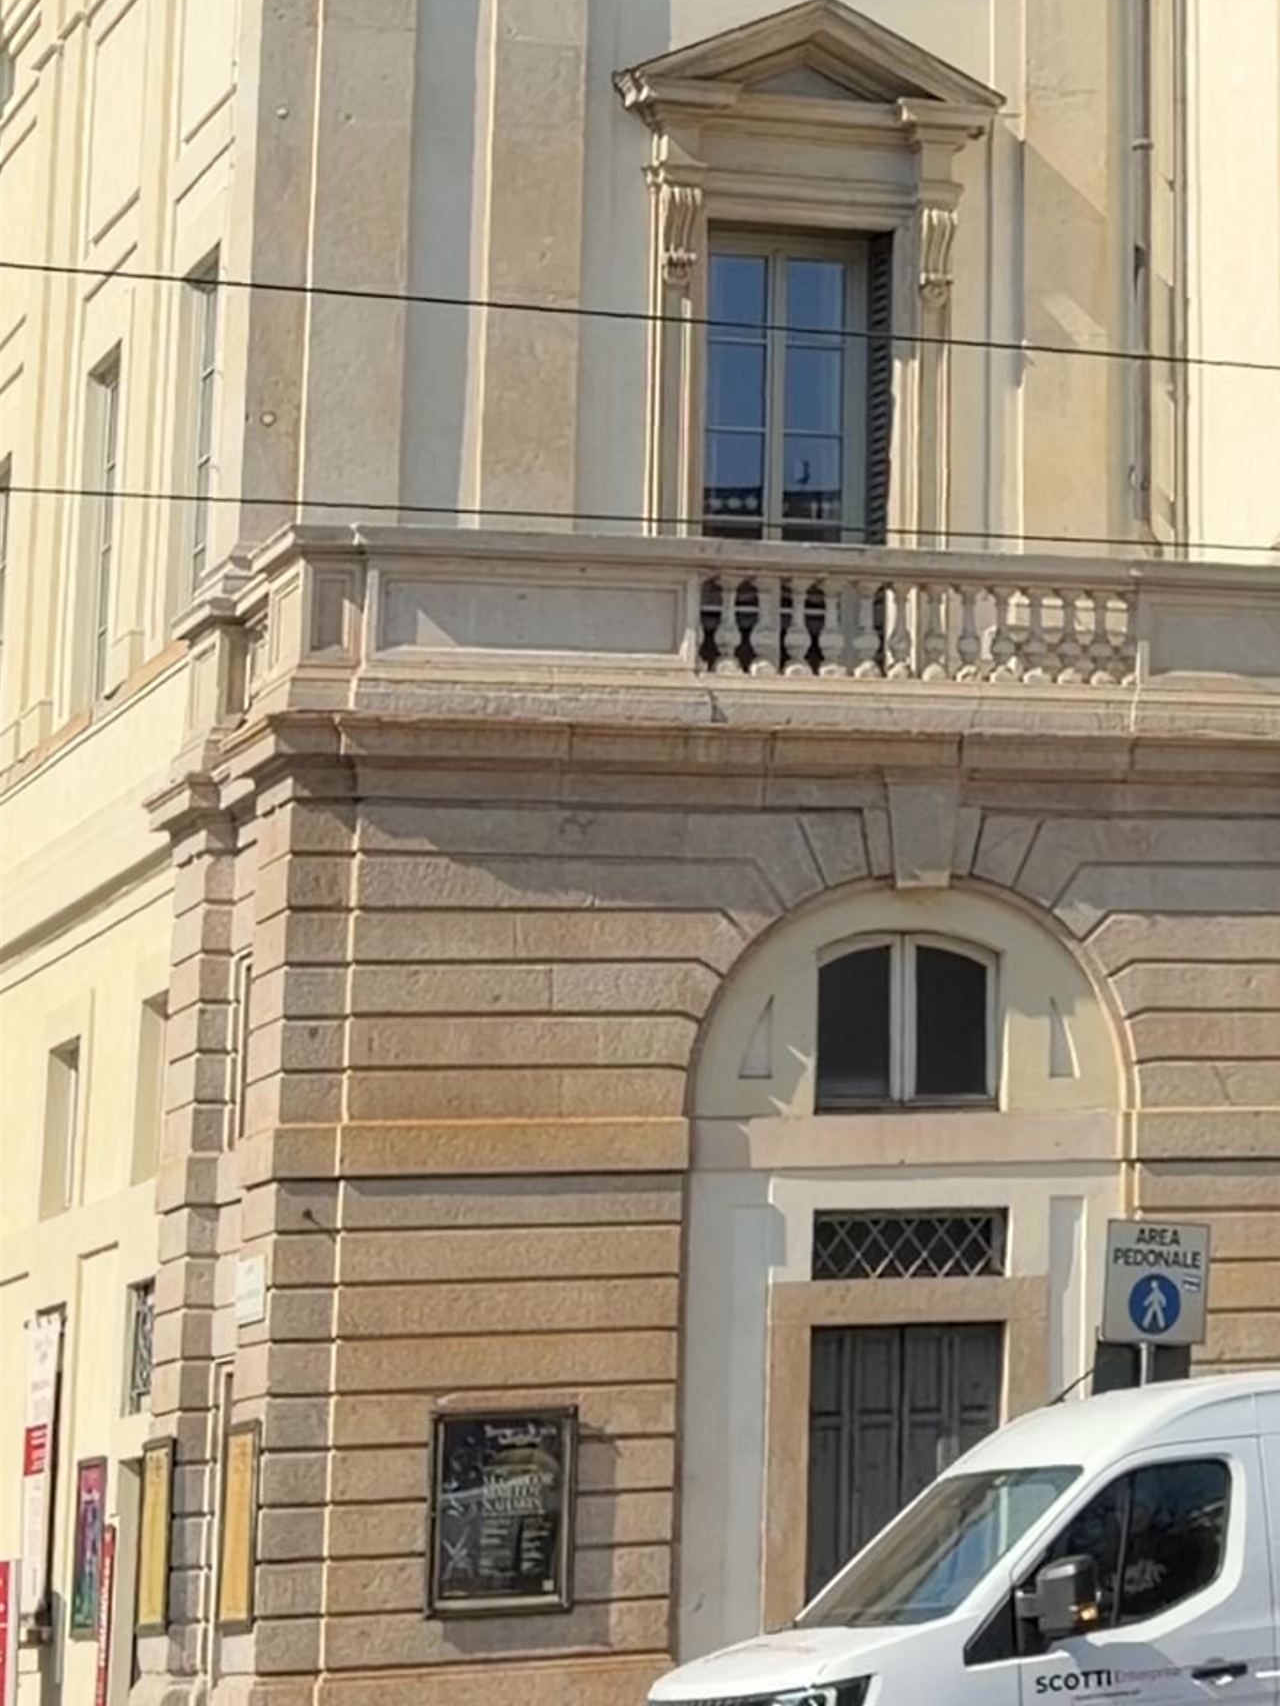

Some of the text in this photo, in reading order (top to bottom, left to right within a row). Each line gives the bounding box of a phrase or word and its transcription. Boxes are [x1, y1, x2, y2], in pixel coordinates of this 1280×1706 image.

[1136, 1227, 1181, 1247] AREA
[1112, 1247, 1202, 1270] PEDONALE
[1035, 1669, 1112, 1694] SCOTTI
